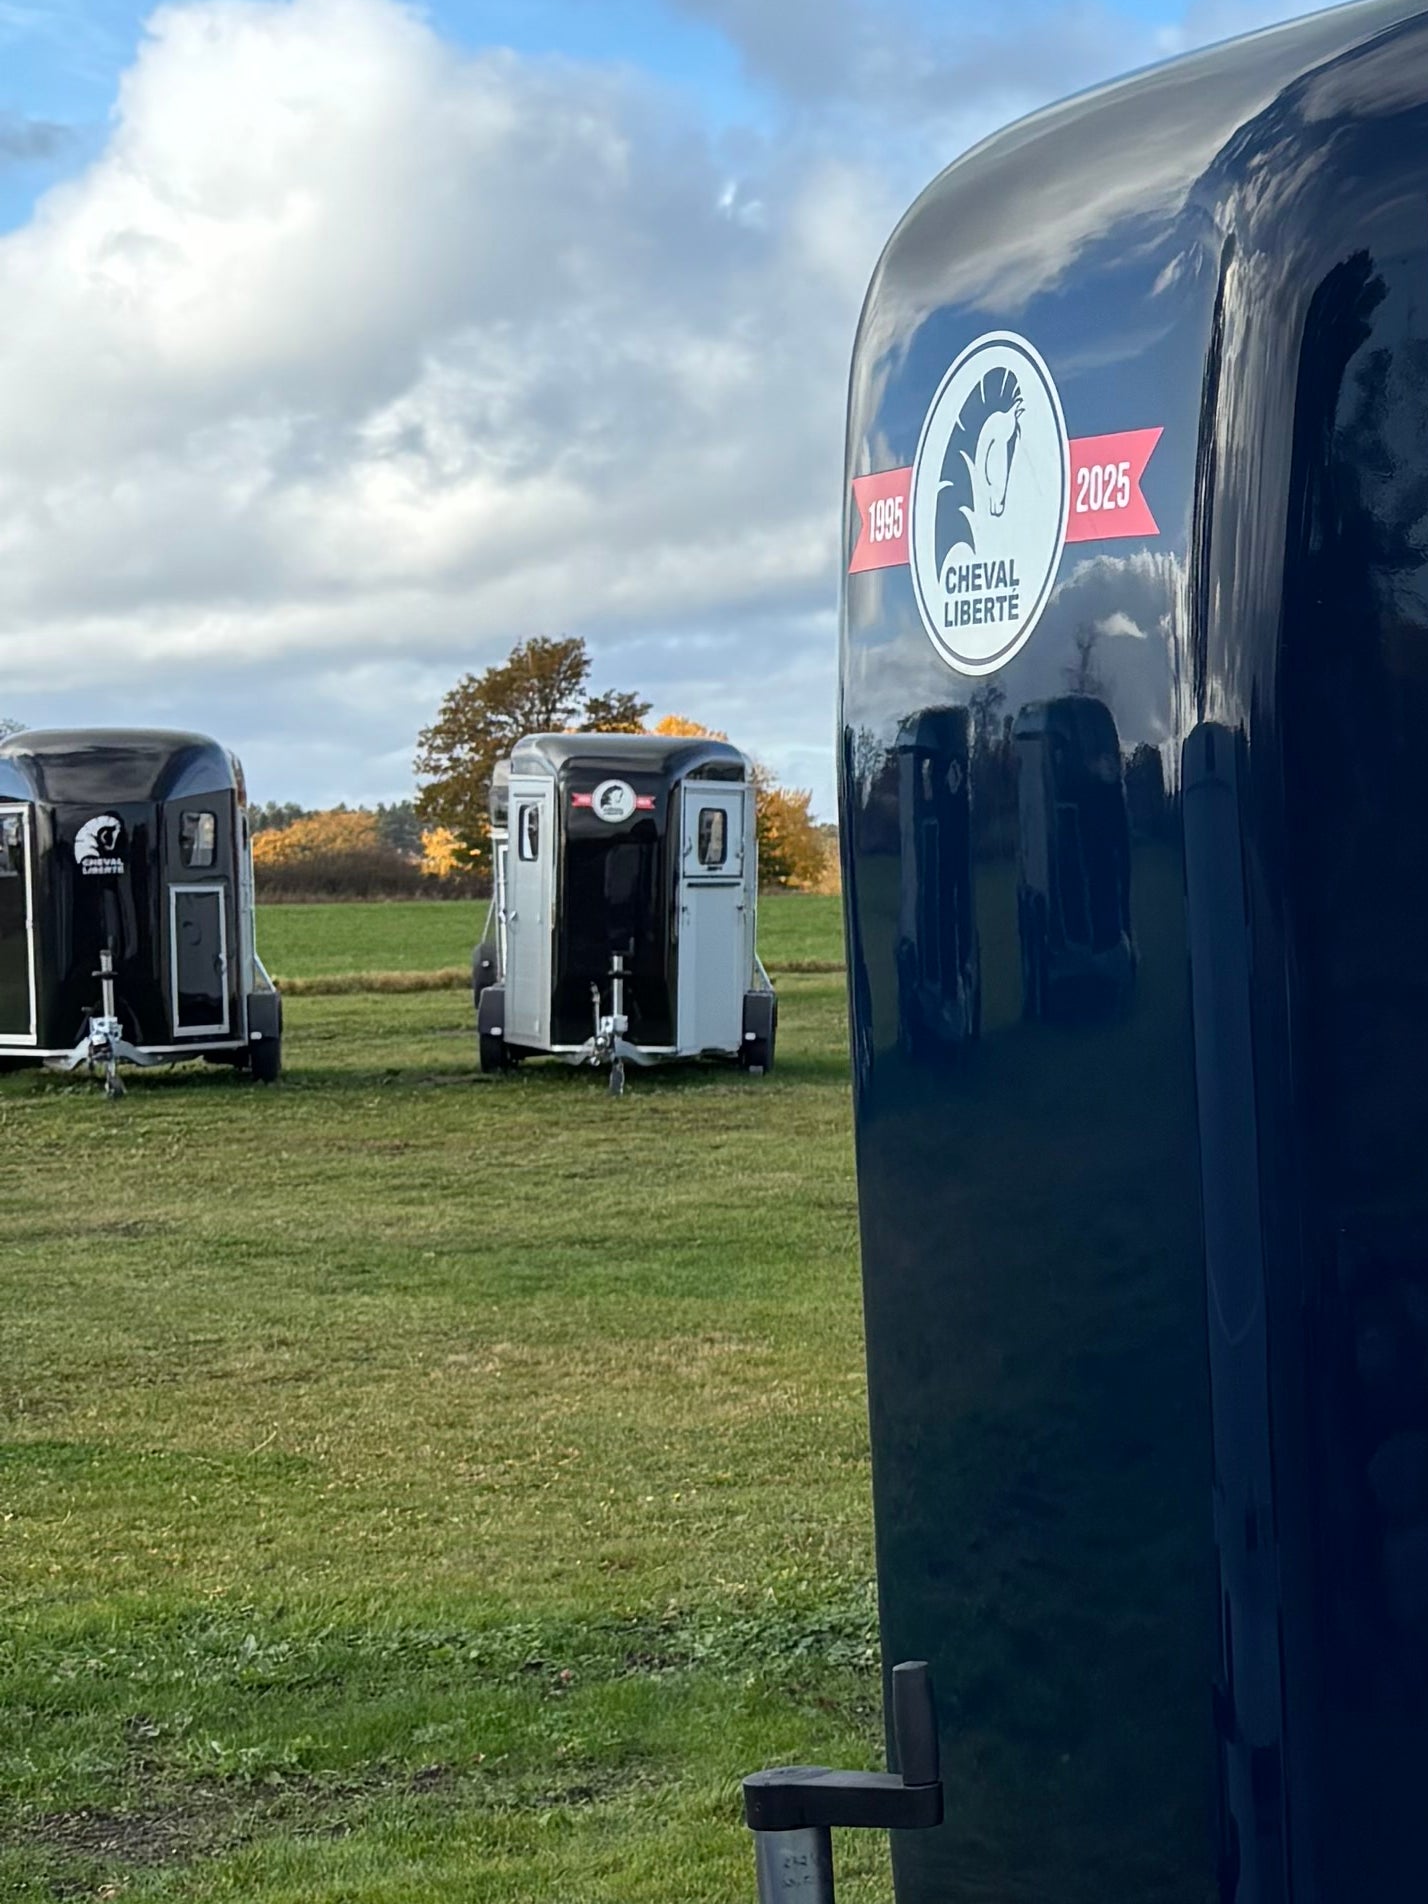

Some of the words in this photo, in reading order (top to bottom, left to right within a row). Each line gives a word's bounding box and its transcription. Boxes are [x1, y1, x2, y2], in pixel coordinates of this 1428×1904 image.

[1075, 461, 1131, 514] 2025
[868, 495, 904, 544] 1995
[945, 558, 1020, 595] CHEVAL
[944, 587, 1020, 628] LIBERTÉ
